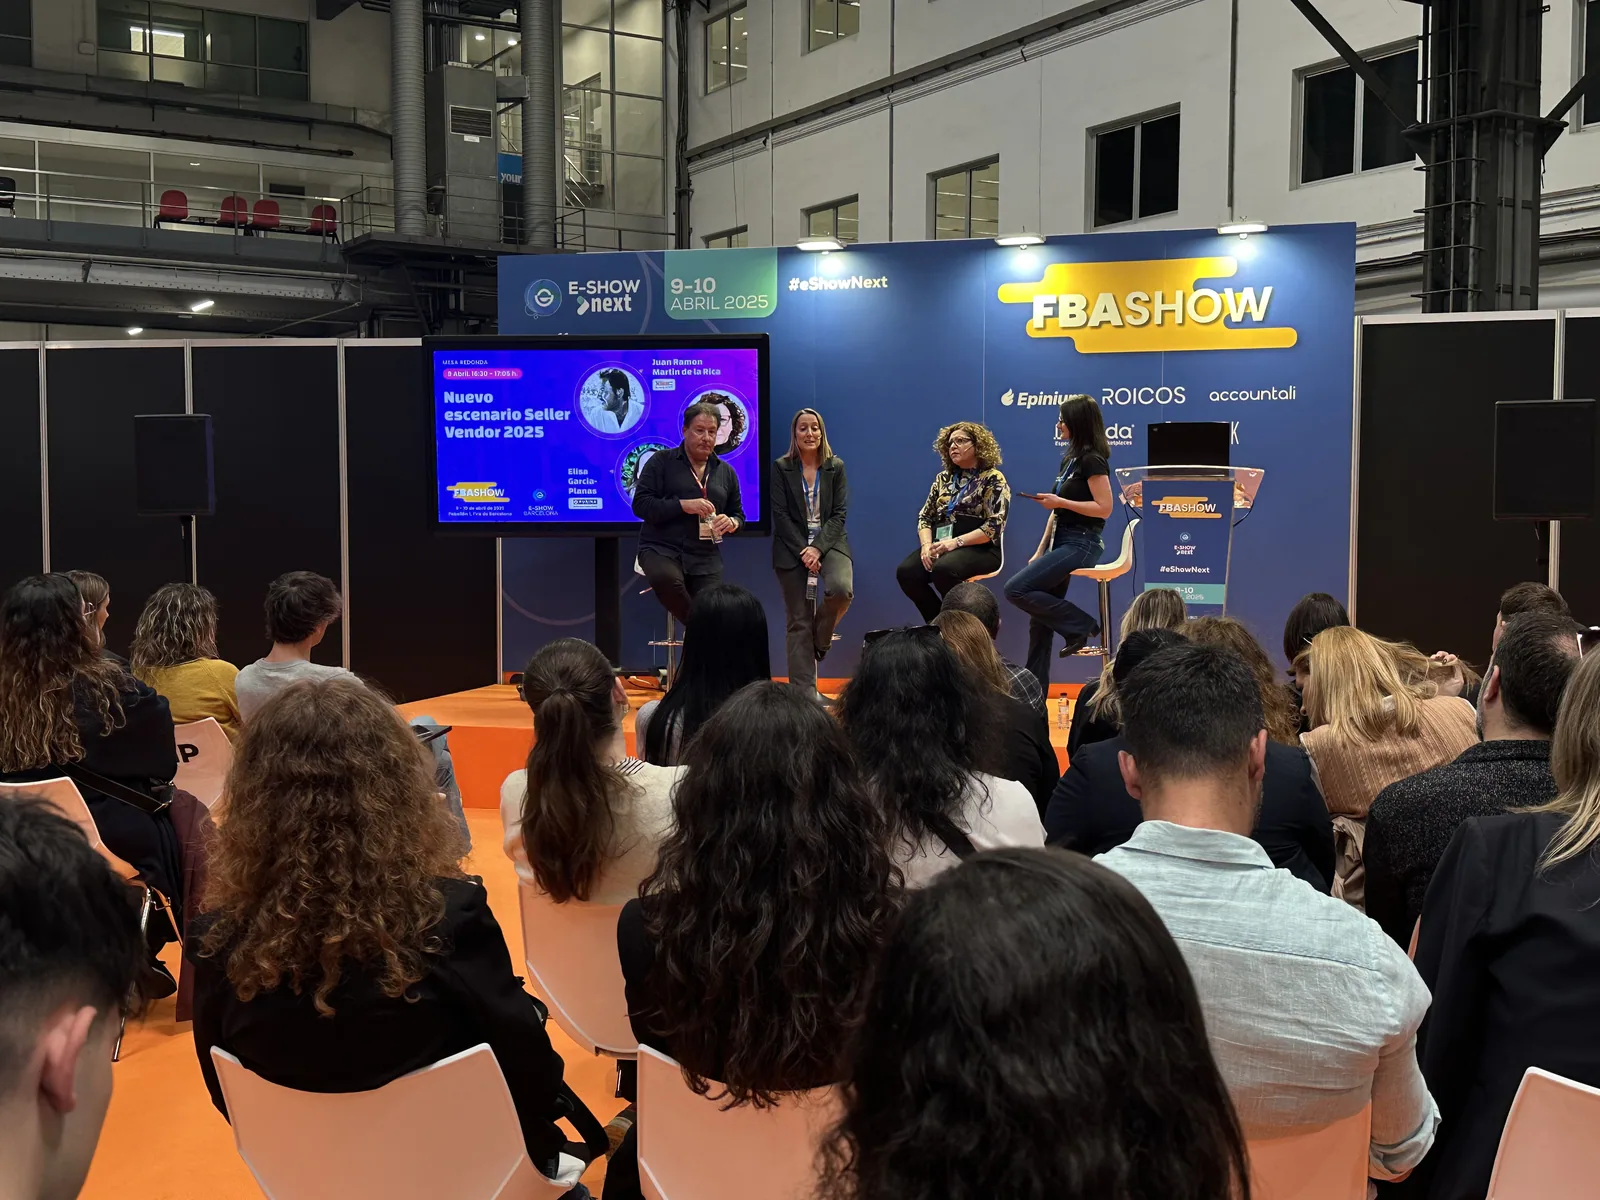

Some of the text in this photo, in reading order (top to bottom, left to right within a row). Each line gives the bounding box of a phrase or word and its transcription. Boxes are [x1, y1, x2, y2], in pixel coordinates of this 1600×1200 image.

[500, 172, 522, 184] your
[568, 279, 641, 295] E-SHOW
[670, 277, 717, 295] 9-10
[788, 275, 888, 292] #eShowNext
[590, 293, 632, 313] next
[670, 294, 769, 311] ABRIL 2025
[1031, 285, 1273, 330] FBASHOW
[651, 358, 672, 366] Juan
[681, 368, 692, 376] de
[693, 368, 702, 376] la
[703, 368, 721, 376] Rica
[443, 391, 494, 404] Nuevo
[1101, 386, 1186, 406] ROICOS
[1209, 385, 1296, 402] accountali
[444, 408, 571, 421] escenario Seller
[444, 425, 544, 439] Vendor 2025
[567, 467, 588, 475] Elisa
[453, 488, 505, 497] FBASHOW
[568, 487, 597, 495] Planas
[1158, 503, 1217, 513] FBASHOW
[1159, 565, 1210, 574] #eShowNext
[1185, 593, 1205, 601] 2025
